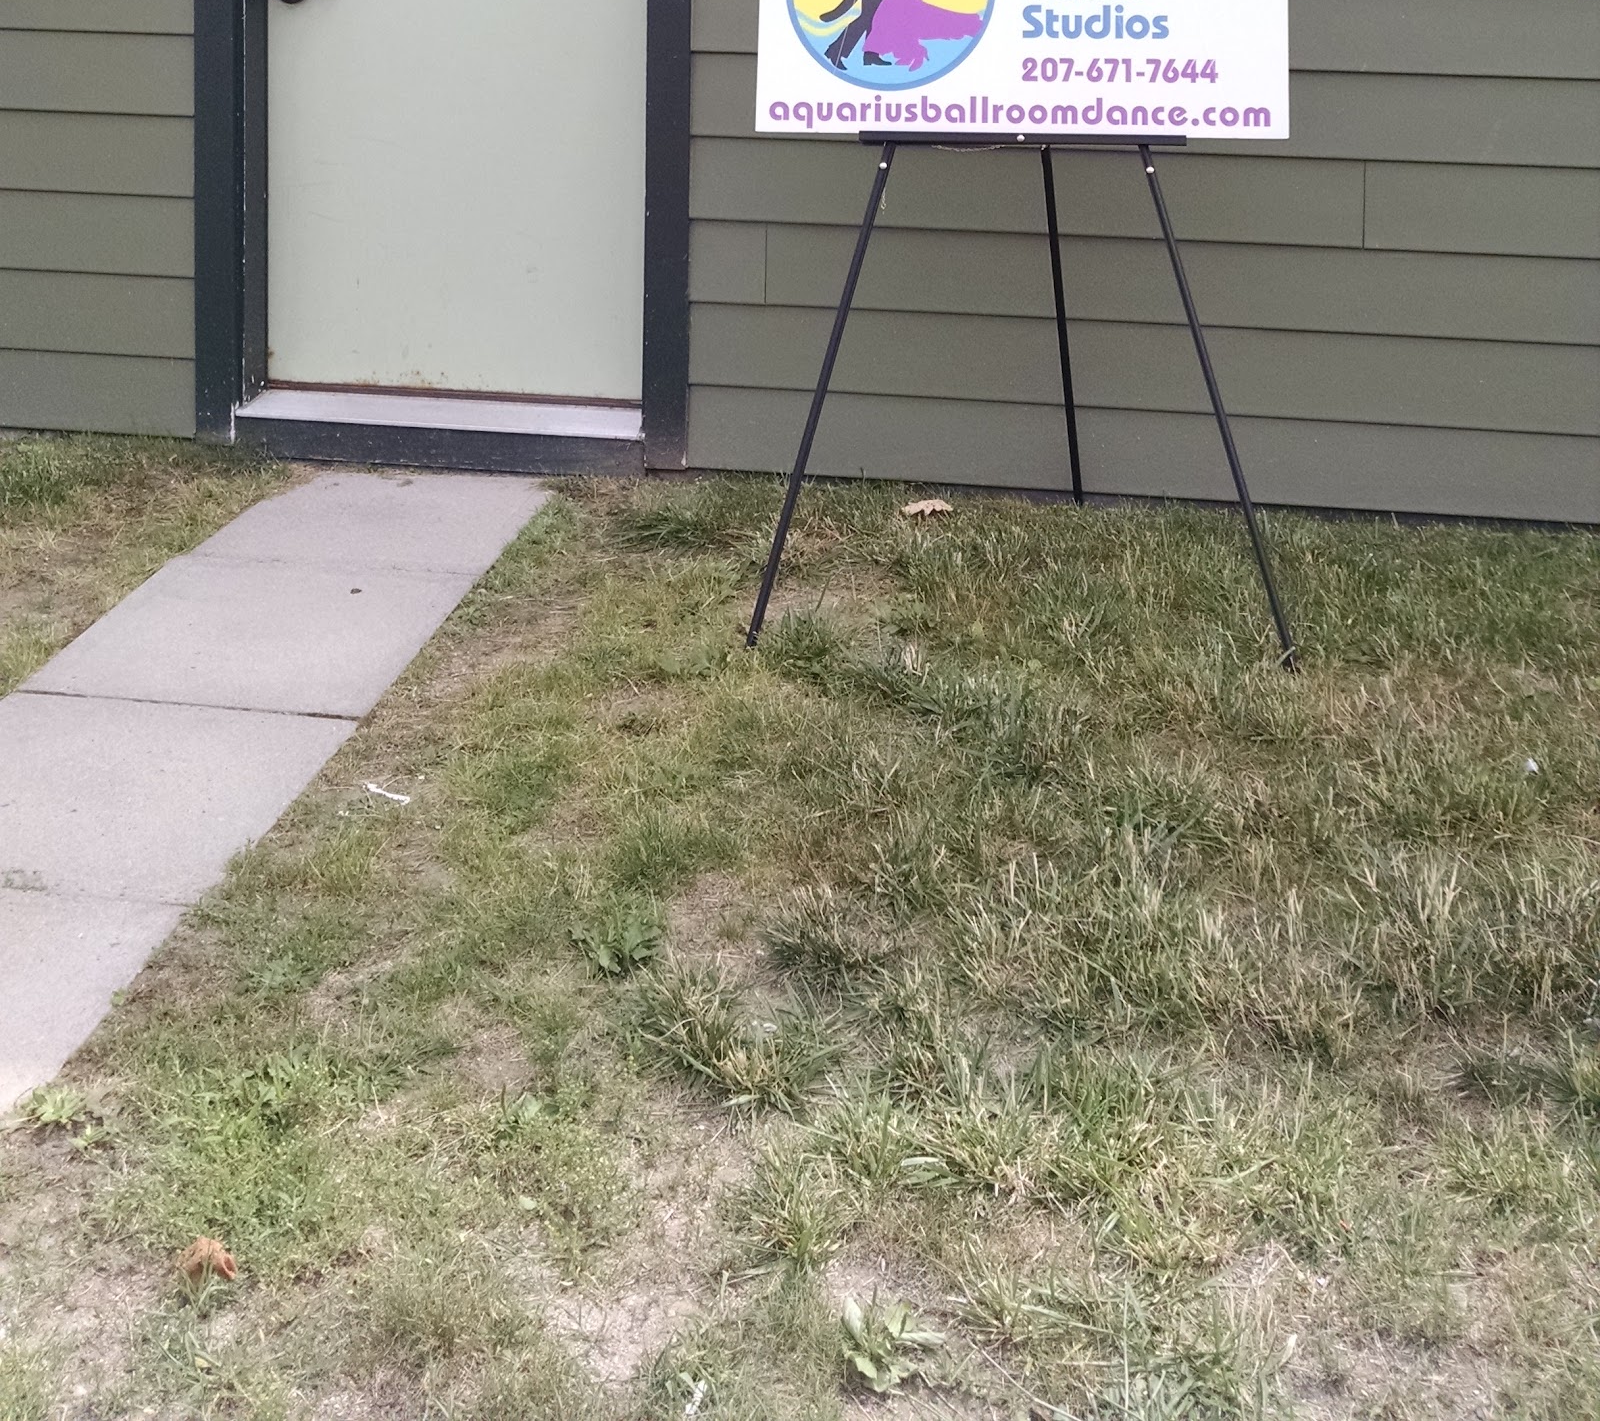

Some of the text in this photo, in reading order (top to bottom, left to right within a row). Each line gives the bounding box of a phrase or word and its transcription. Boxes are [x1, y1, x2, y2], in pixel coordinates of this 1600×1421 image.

[1022, 4, 1170, 40] Studios
[1021, 57, 1220, 84] 207-671-7644
[768, 94, 1272, 130] aquariusballroomdance.com
